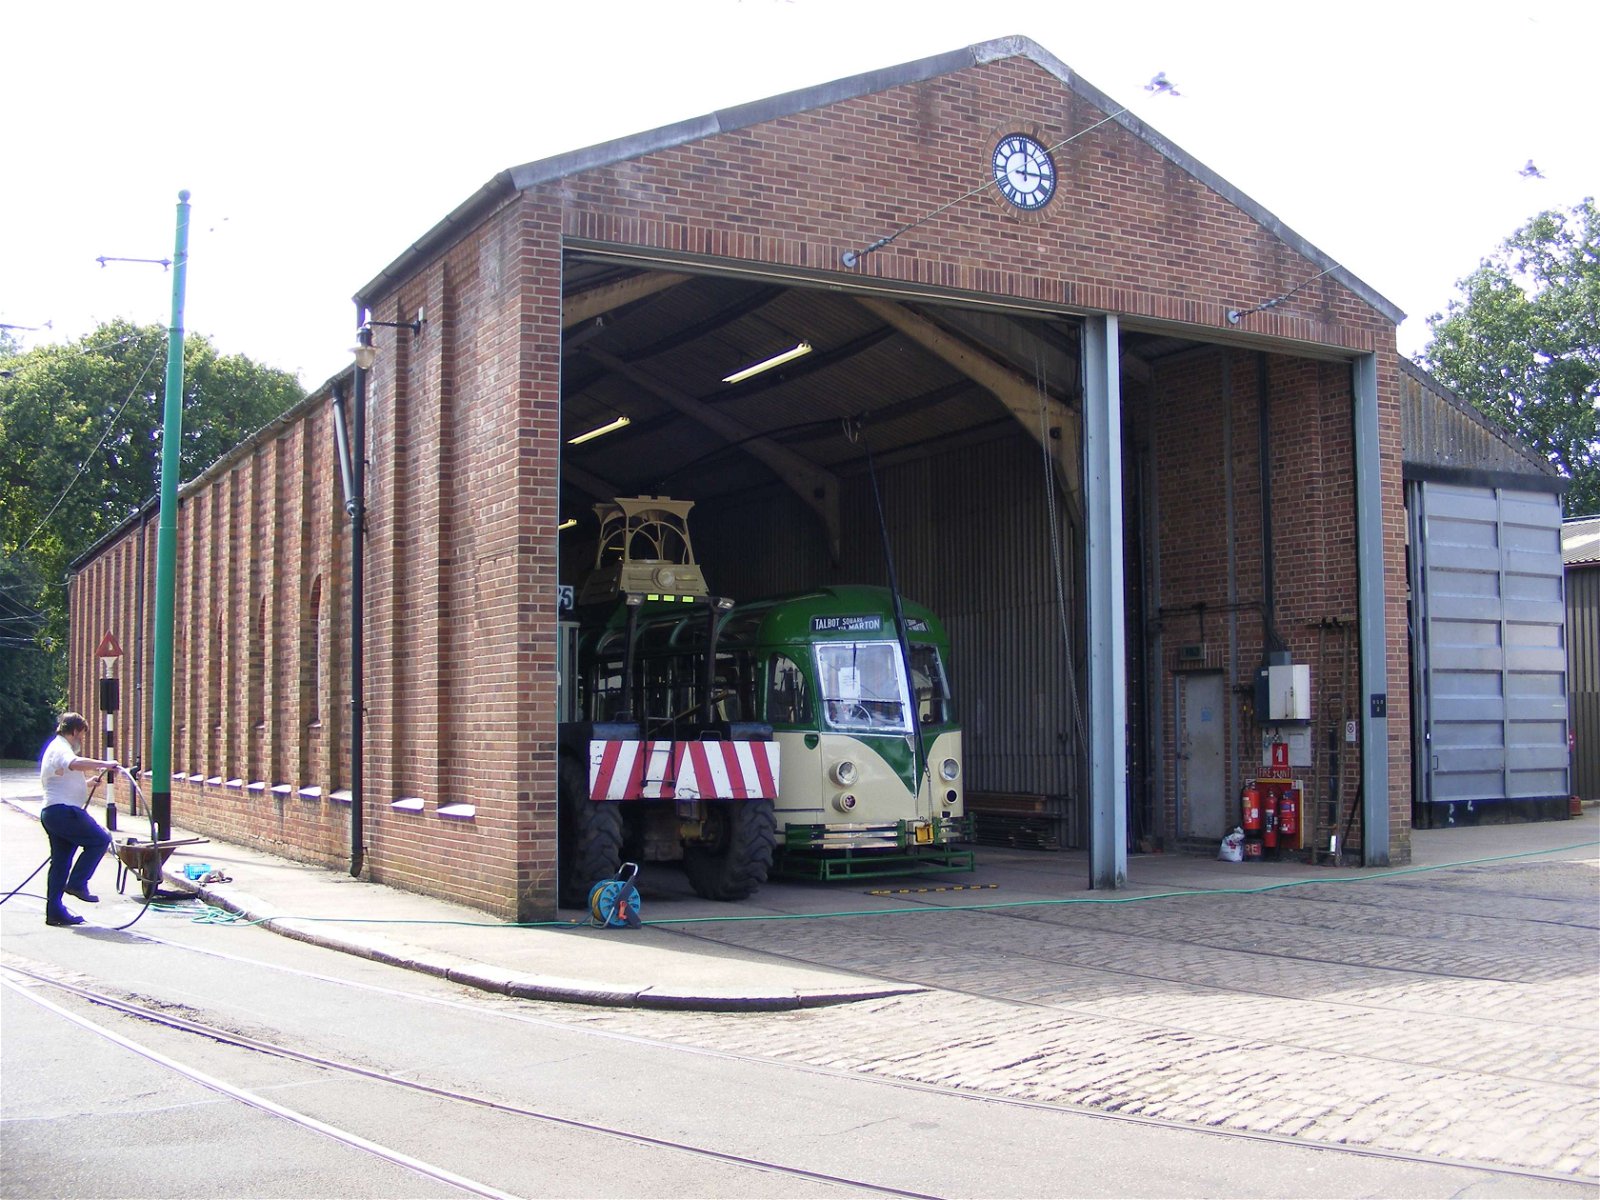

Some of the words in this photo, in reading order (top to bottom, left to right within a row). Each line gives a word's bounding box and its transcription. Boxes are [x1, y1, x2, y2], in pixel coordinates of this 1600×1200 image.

[559, 587, 572, 608] 5
[815, 619, 839, 630] TALBOT
[842, 617, 863, 625] SQUARE
[848, 619, 880, 630] MARTON
